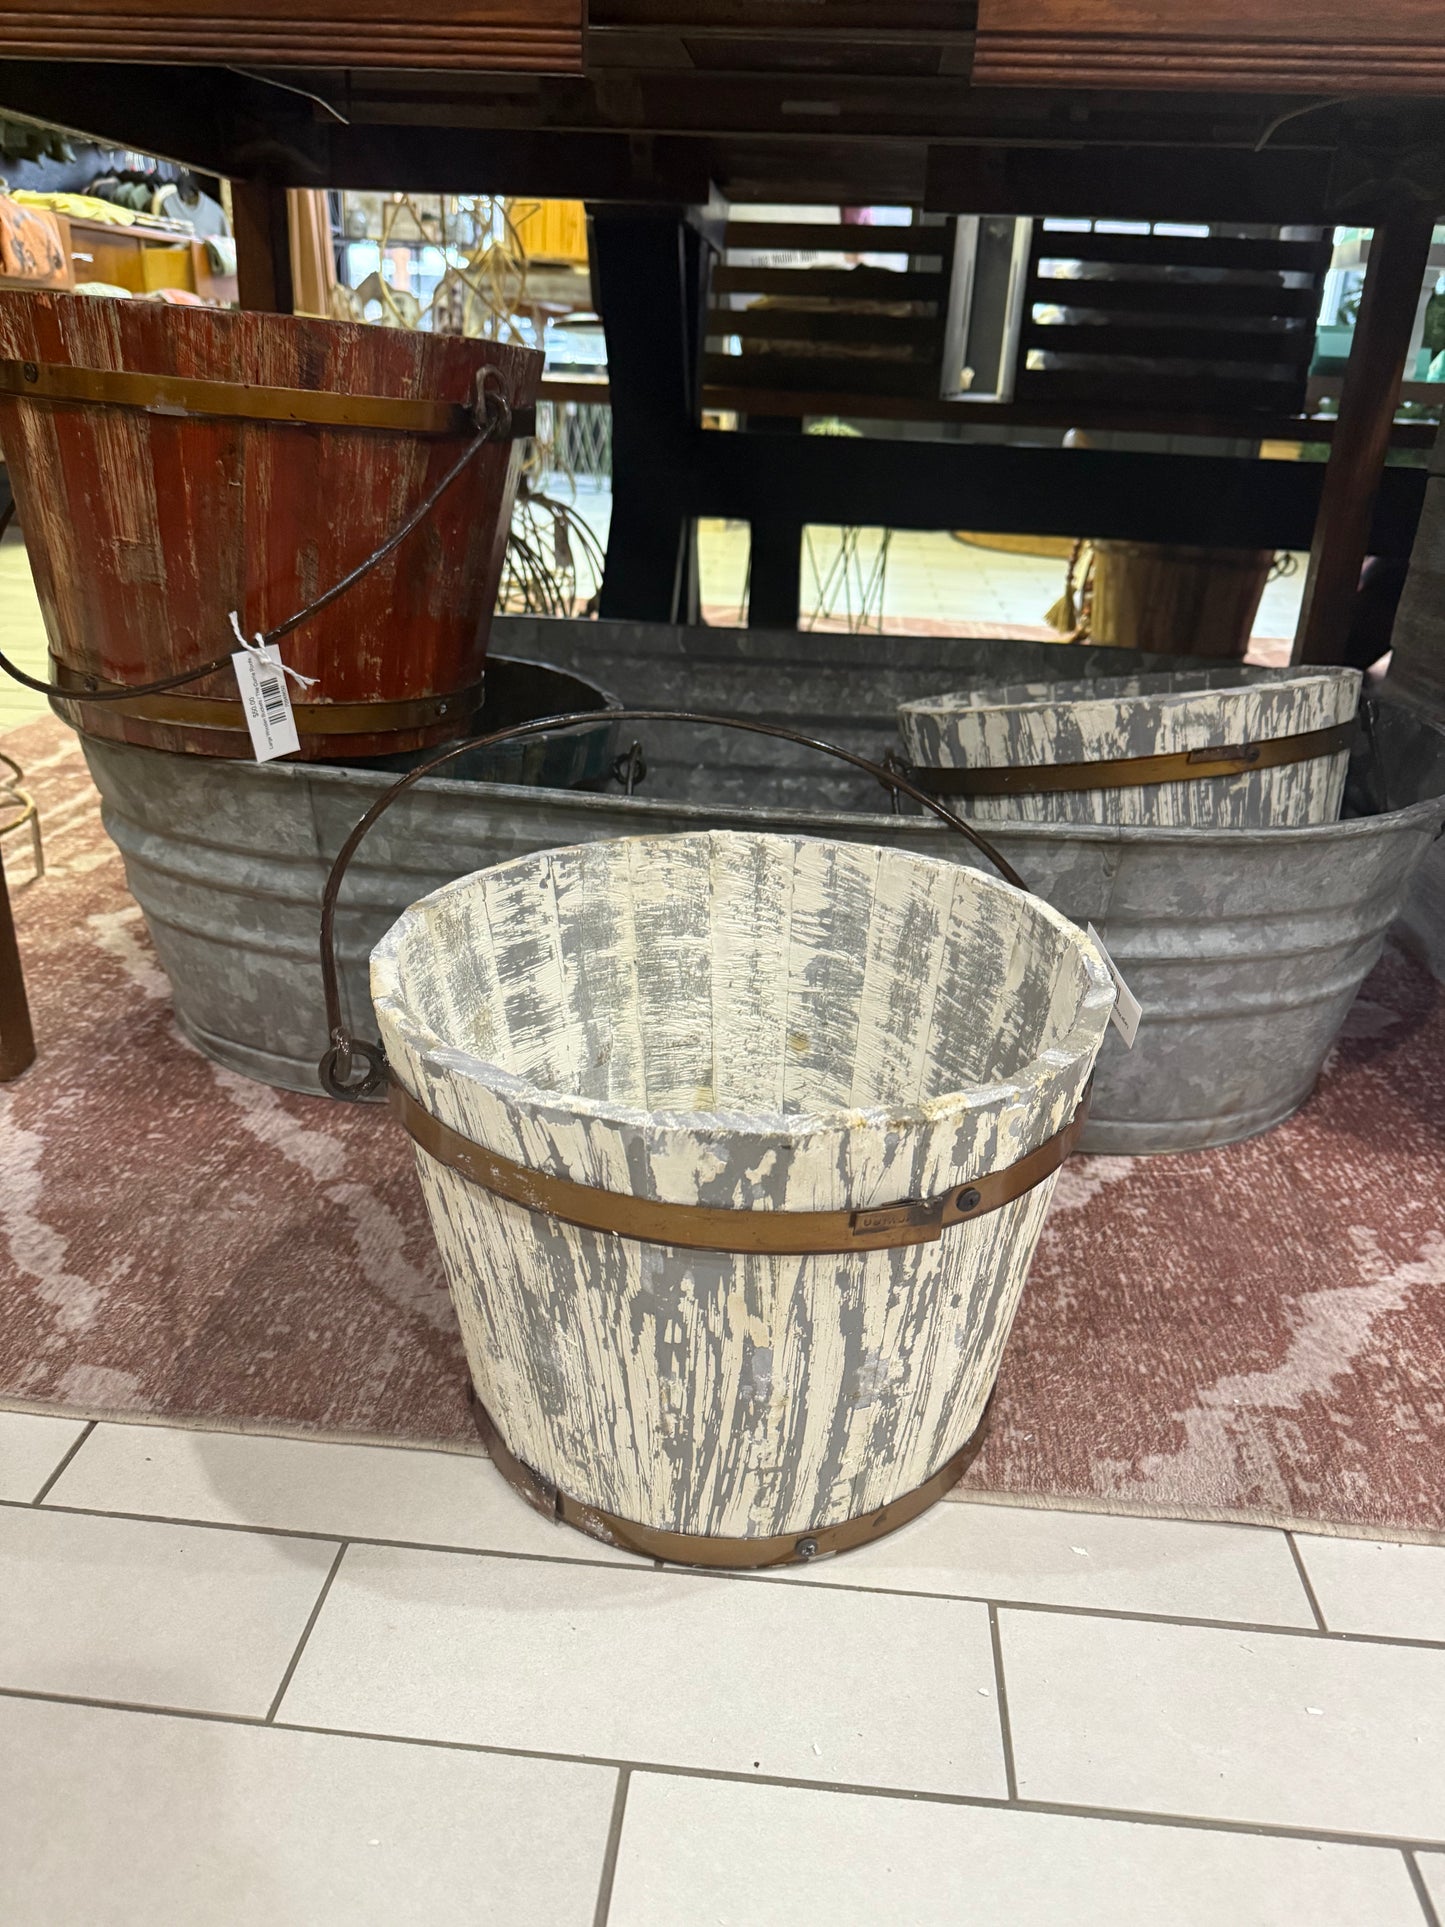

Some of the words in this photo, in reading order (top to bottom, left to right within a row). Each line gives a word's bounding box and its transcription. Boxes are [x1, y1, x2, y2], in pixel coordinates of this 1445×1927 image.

[248, 696, 259, 718] $50.00
[258, 699, 266, 718] Buckets
[262, 717, 270, 736] Wooden
